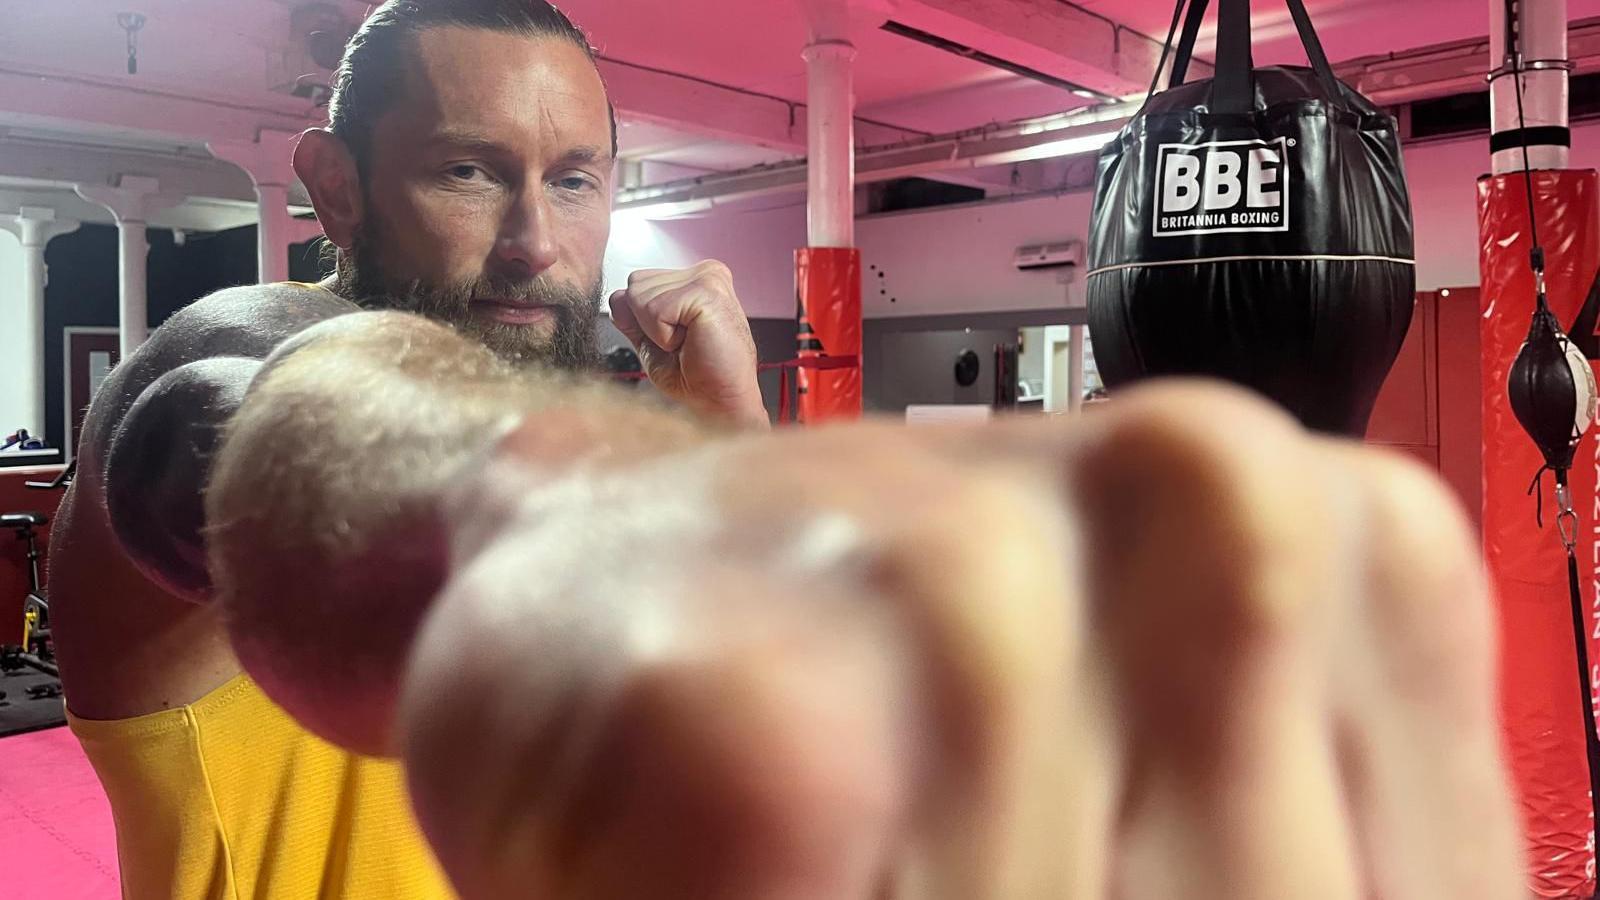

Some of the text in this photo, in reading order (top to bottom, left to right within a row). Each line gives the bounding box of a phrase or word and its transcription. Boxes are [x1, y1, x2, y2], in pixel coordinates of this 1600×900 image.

[1163, 149, 1280, 212] BBE
[1161, 212, 1280, 228] BRITANNIA BOXING
